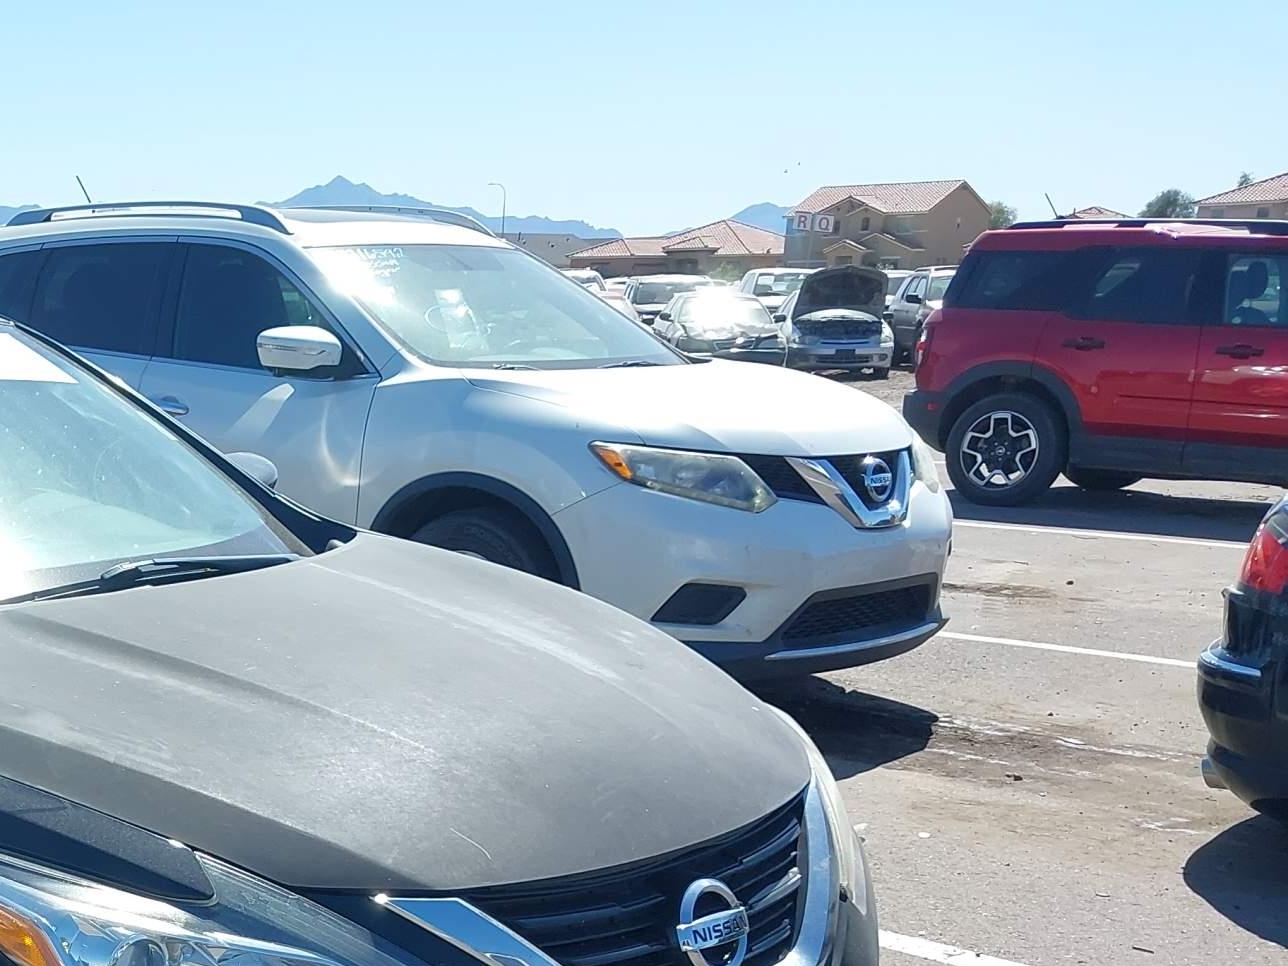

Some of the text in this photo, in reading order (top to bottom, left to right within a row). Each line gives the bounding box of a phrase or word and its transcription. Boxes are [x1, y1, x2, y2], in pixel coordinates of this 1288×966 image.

[797, 215, 808, 229] R
[818, 217, 830, 230] Q
[691, 915, 746, 945] NISSAN
